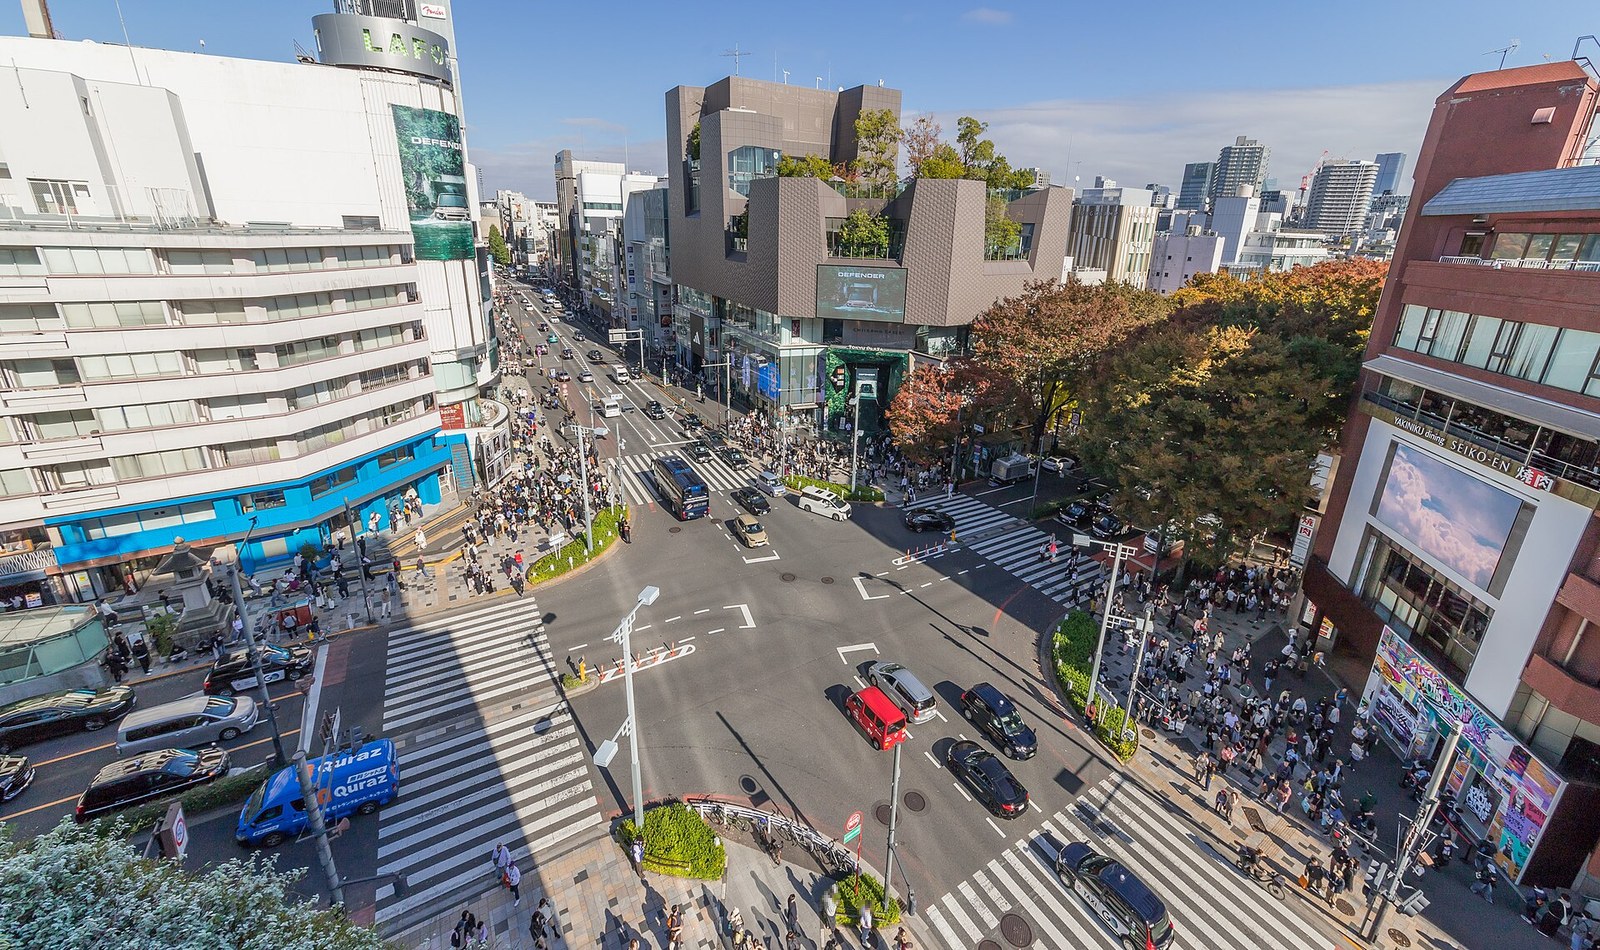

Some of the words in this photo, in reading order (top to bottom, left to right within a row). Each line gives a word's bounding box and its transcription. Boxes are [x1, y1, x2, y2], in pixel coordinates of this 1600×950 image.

[837, 271, 885, 279] DEFENDER
[1393, 416, 1425, 436] YAKINIKU
[1424, 430, 1446, 447] dining
[1450, 440, 1511, 473] SEIKO-EN
[1515, 466, 1554, 492] 焼肉
[333, 774, 388, 798] Quraz
[1083, 890, 1099, 908] TAXI
